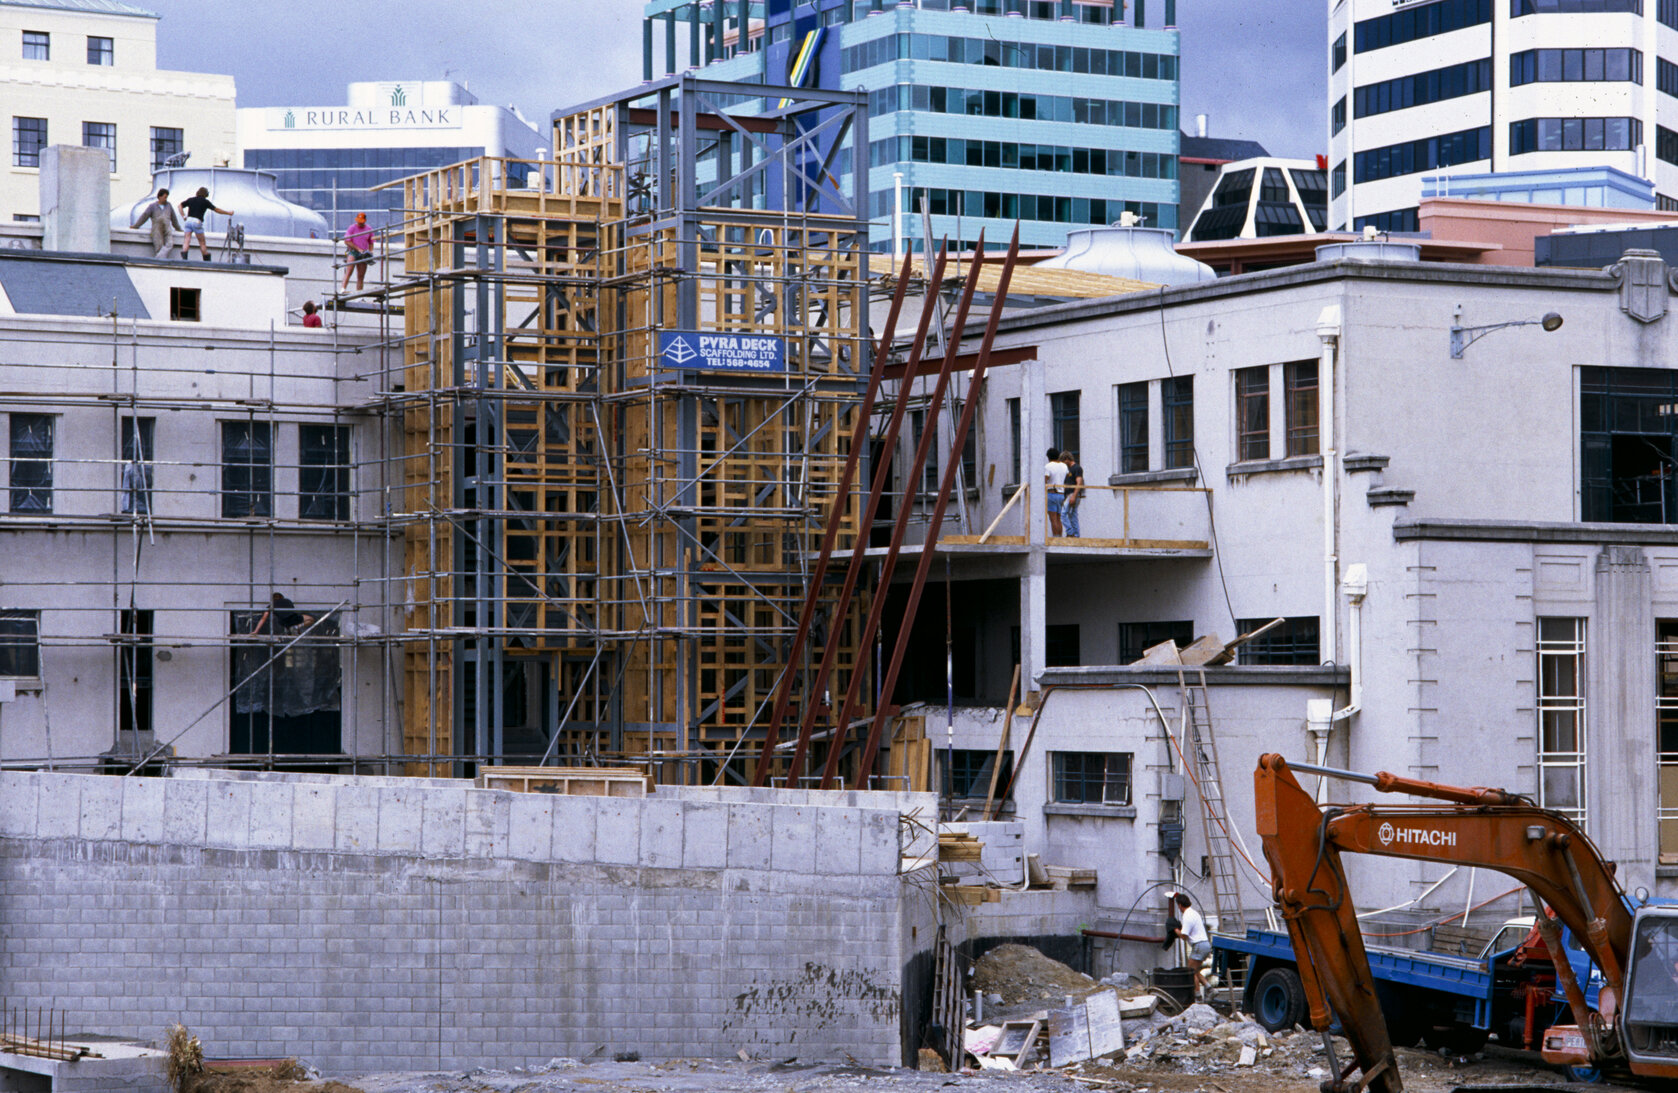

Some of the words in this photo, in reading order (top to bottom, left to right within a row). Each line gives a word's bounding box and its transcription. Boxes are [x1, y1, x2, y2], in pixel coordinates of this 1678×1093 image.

[307, 110, 378, 126] RURAL
[390, 109, 450, 124] BANK
[699, 336, 738, 350] PYRA
[741, 338, 777, 352] DECK
[700, 348, 757, 359] SCAFFOLDING
[760, 351, 777, 360] LTD.
[1396, 827, 1457, 846] HITACHI
